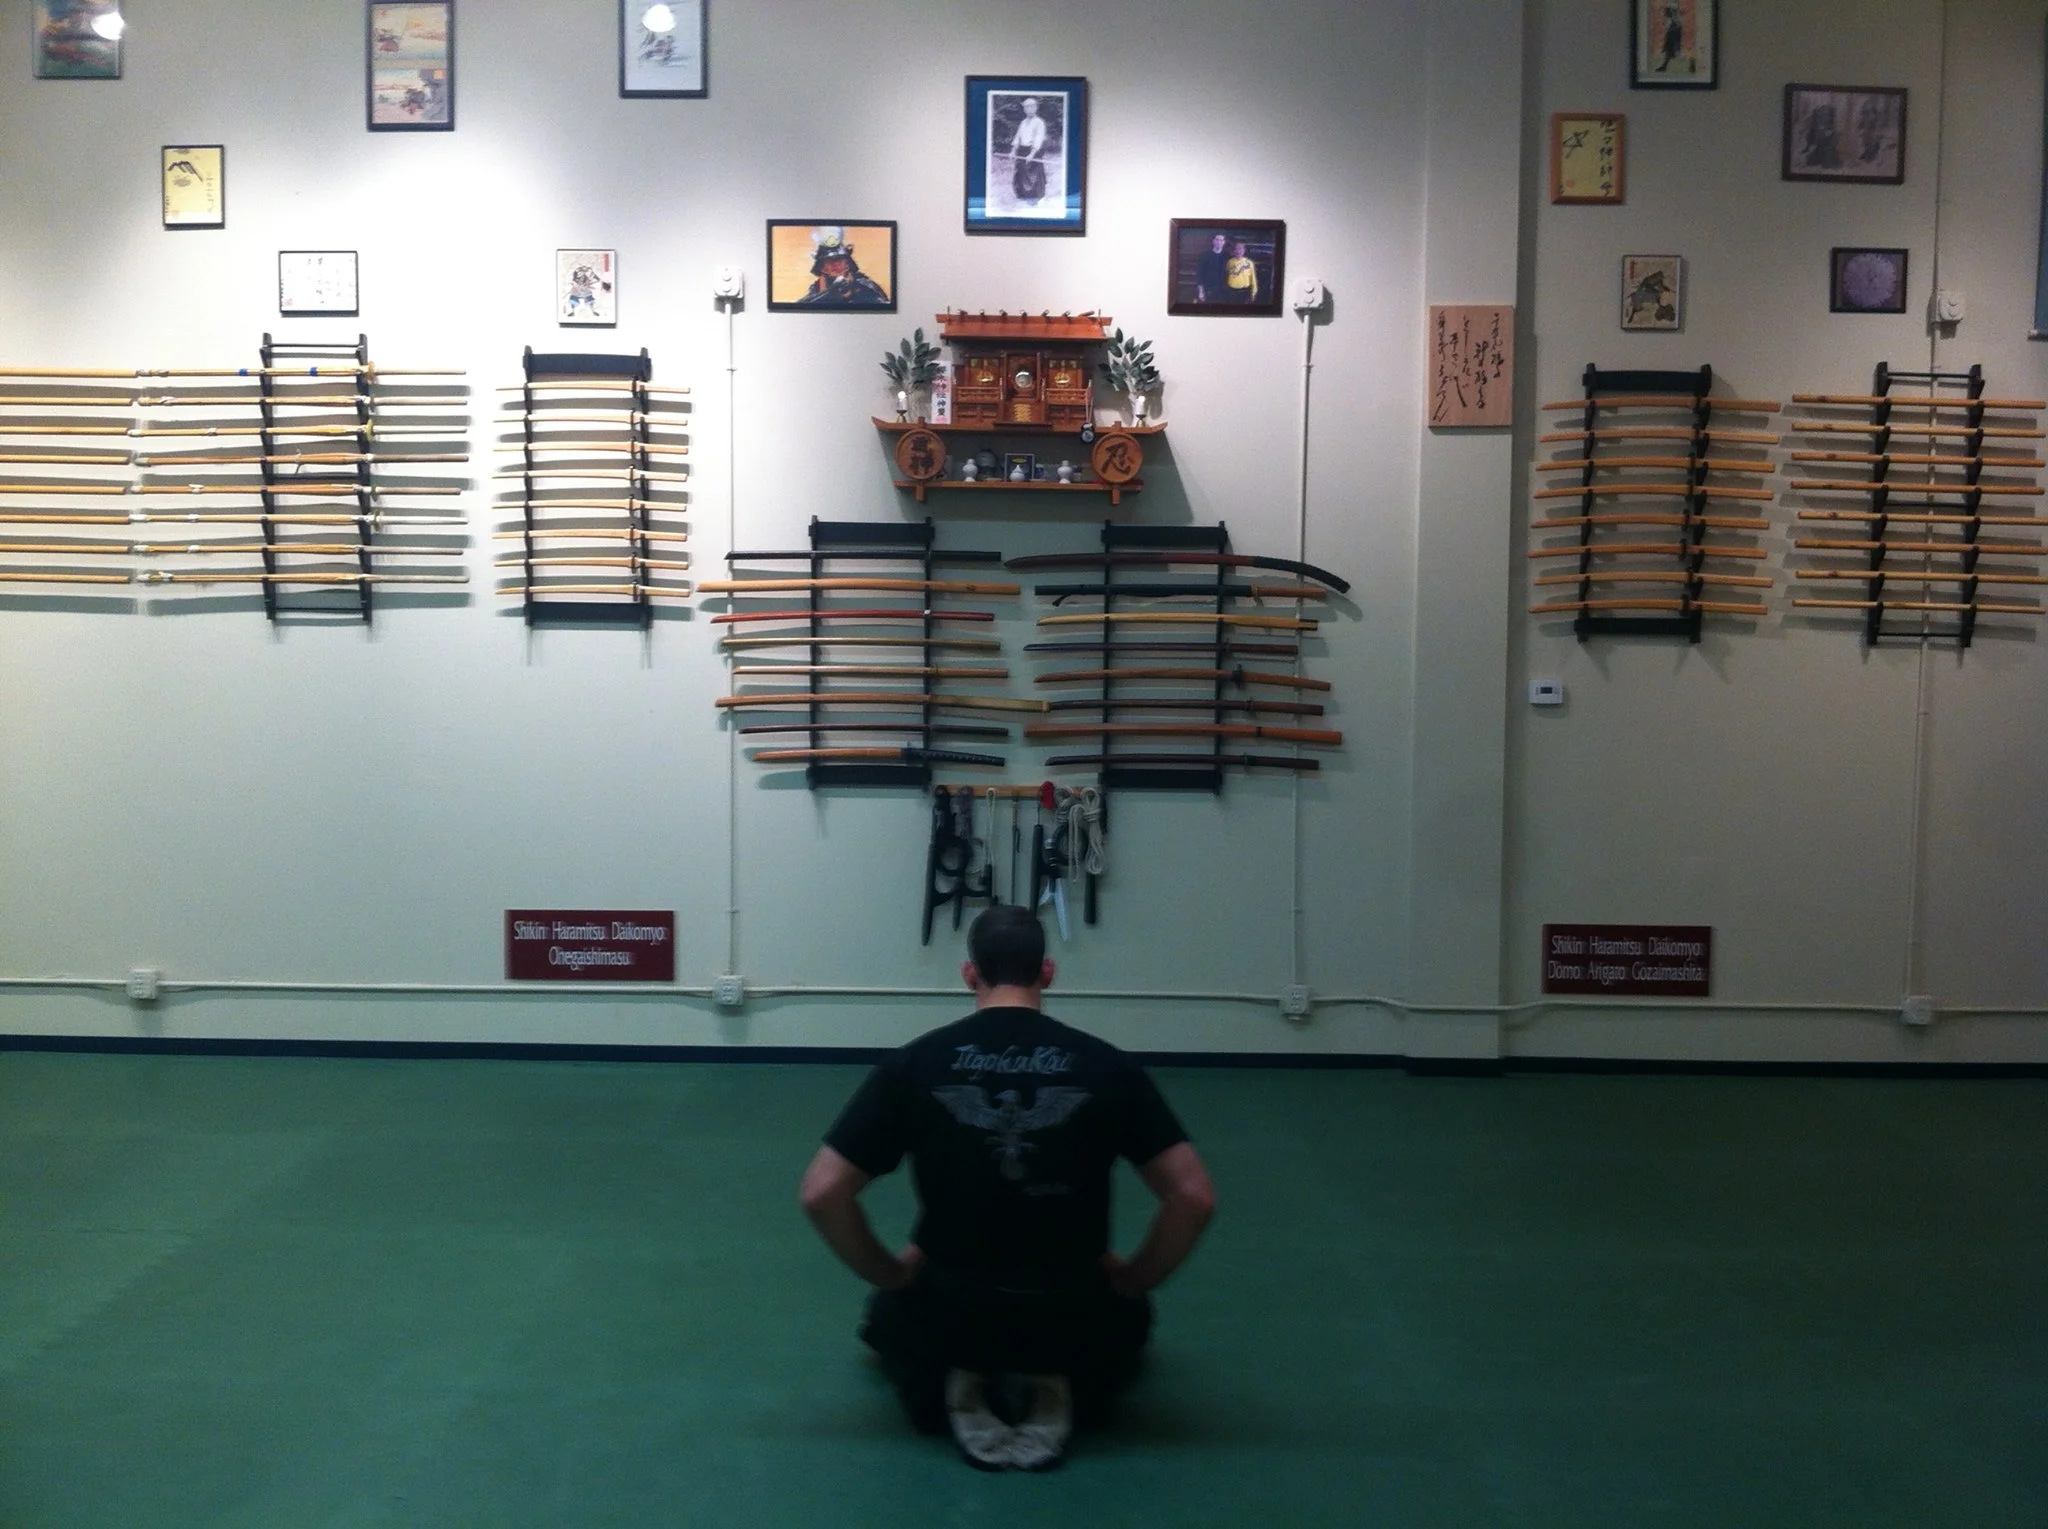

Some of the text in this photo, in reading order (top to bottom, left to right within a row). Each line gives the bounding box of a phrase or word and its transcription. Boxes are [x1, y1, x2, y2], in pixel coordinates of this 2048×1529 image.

[513, 920, 666, 945] Shikin Haramitsu Daikomyo
[548, 946, 633, 971] Onegaishimasu
[1551, 935, 1702, 960] Shikin Haramitsu Daikomyo
[1548, 961, 1580, 979] Domo
[1587, 961, 1626, 985] Arigato
